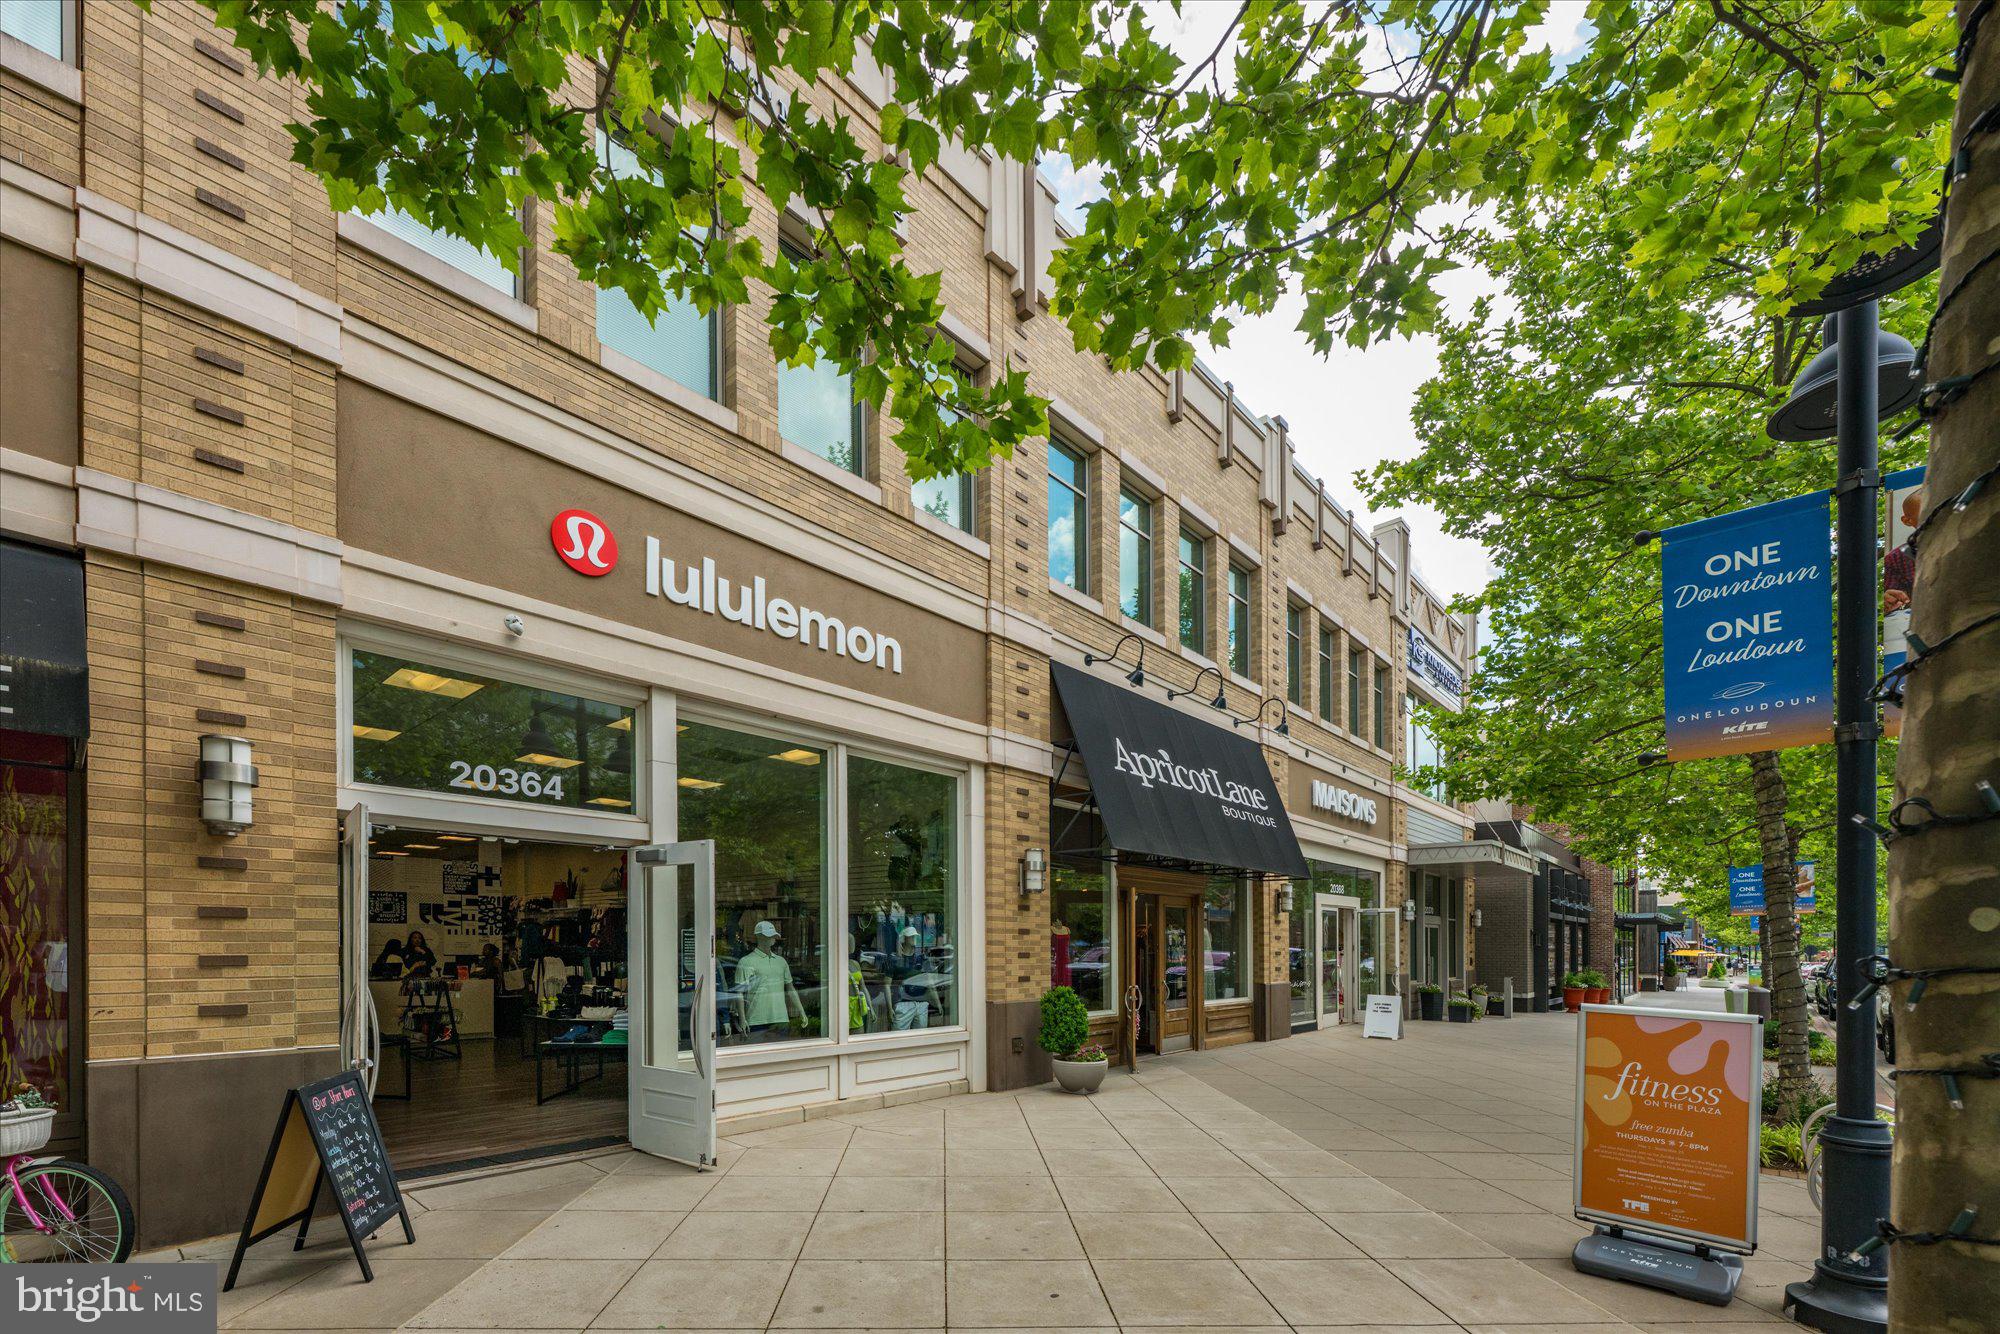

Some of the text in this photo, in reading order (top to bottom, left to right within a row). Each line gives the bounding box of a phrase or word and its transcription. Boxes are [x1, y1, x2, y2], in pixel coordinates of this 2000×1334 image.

[1704, 541, 1781, 576] ONE
[646, 535, 902, 674] lululemon
[1673, 564, 1820, 609] Downtown
[1705, 609, 1783, 643] ONE
[1687, 636, 1806, 673] Loudoun
[448, 760, 565, 800] 20364
[1221, 805, 1277, 828] BOUTIQUE
[1311, 779, 1377, 825] MAISONS
[1603, 1061, 1723, 1106] fitness
[1644, 1099, 1722, 1116] ON THE PLAZA
[1615, 1131, 1666, 1145] THURSDAYS
[1629, 1119, 1694, 1139] free zumba
